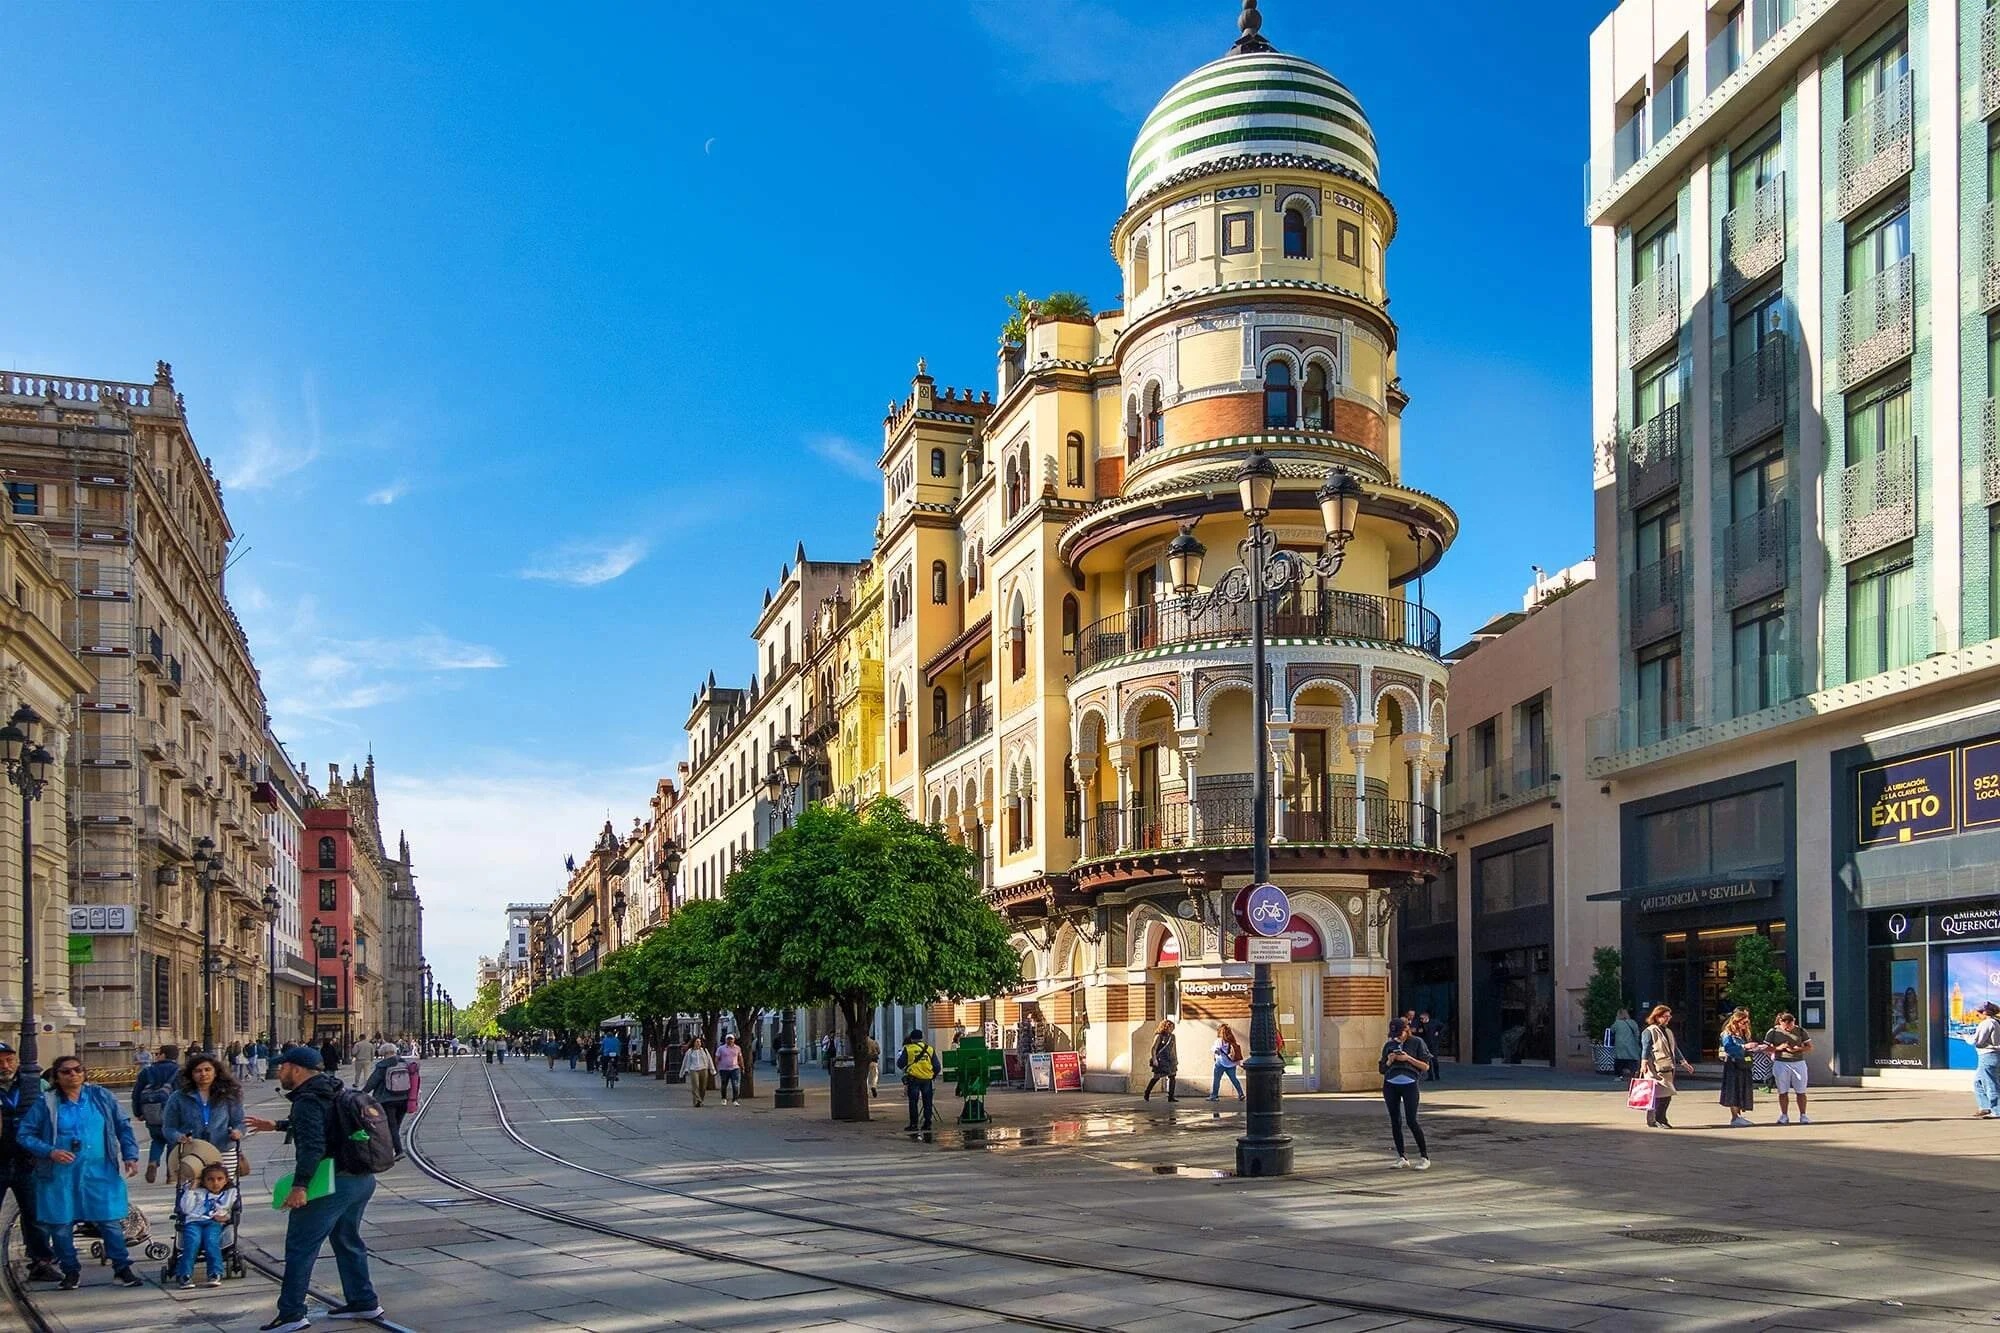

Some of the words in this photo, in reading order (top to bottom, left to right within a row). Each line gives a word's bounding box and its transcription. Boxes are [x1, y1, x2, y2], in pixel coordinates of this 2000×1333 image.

[1893, 778, 1926, 790] UBICACIÓN
[1974, 775, 1998, 790] 952
[1889, 791, 1897, 799] LA
[1898, 788, 1916, 797] CLAVE
[1918, 785, 1930, 793] DEL
[1976, 788, 2000, 800] LOCA
[1871, 795, 1940, 827] ÉXITO
[1641, 888, 1698, 912] QUERENCIA
[1709, 880, 1756, 900] SEVILLA
[1959, 909, 1998, 919] MIRADOR
